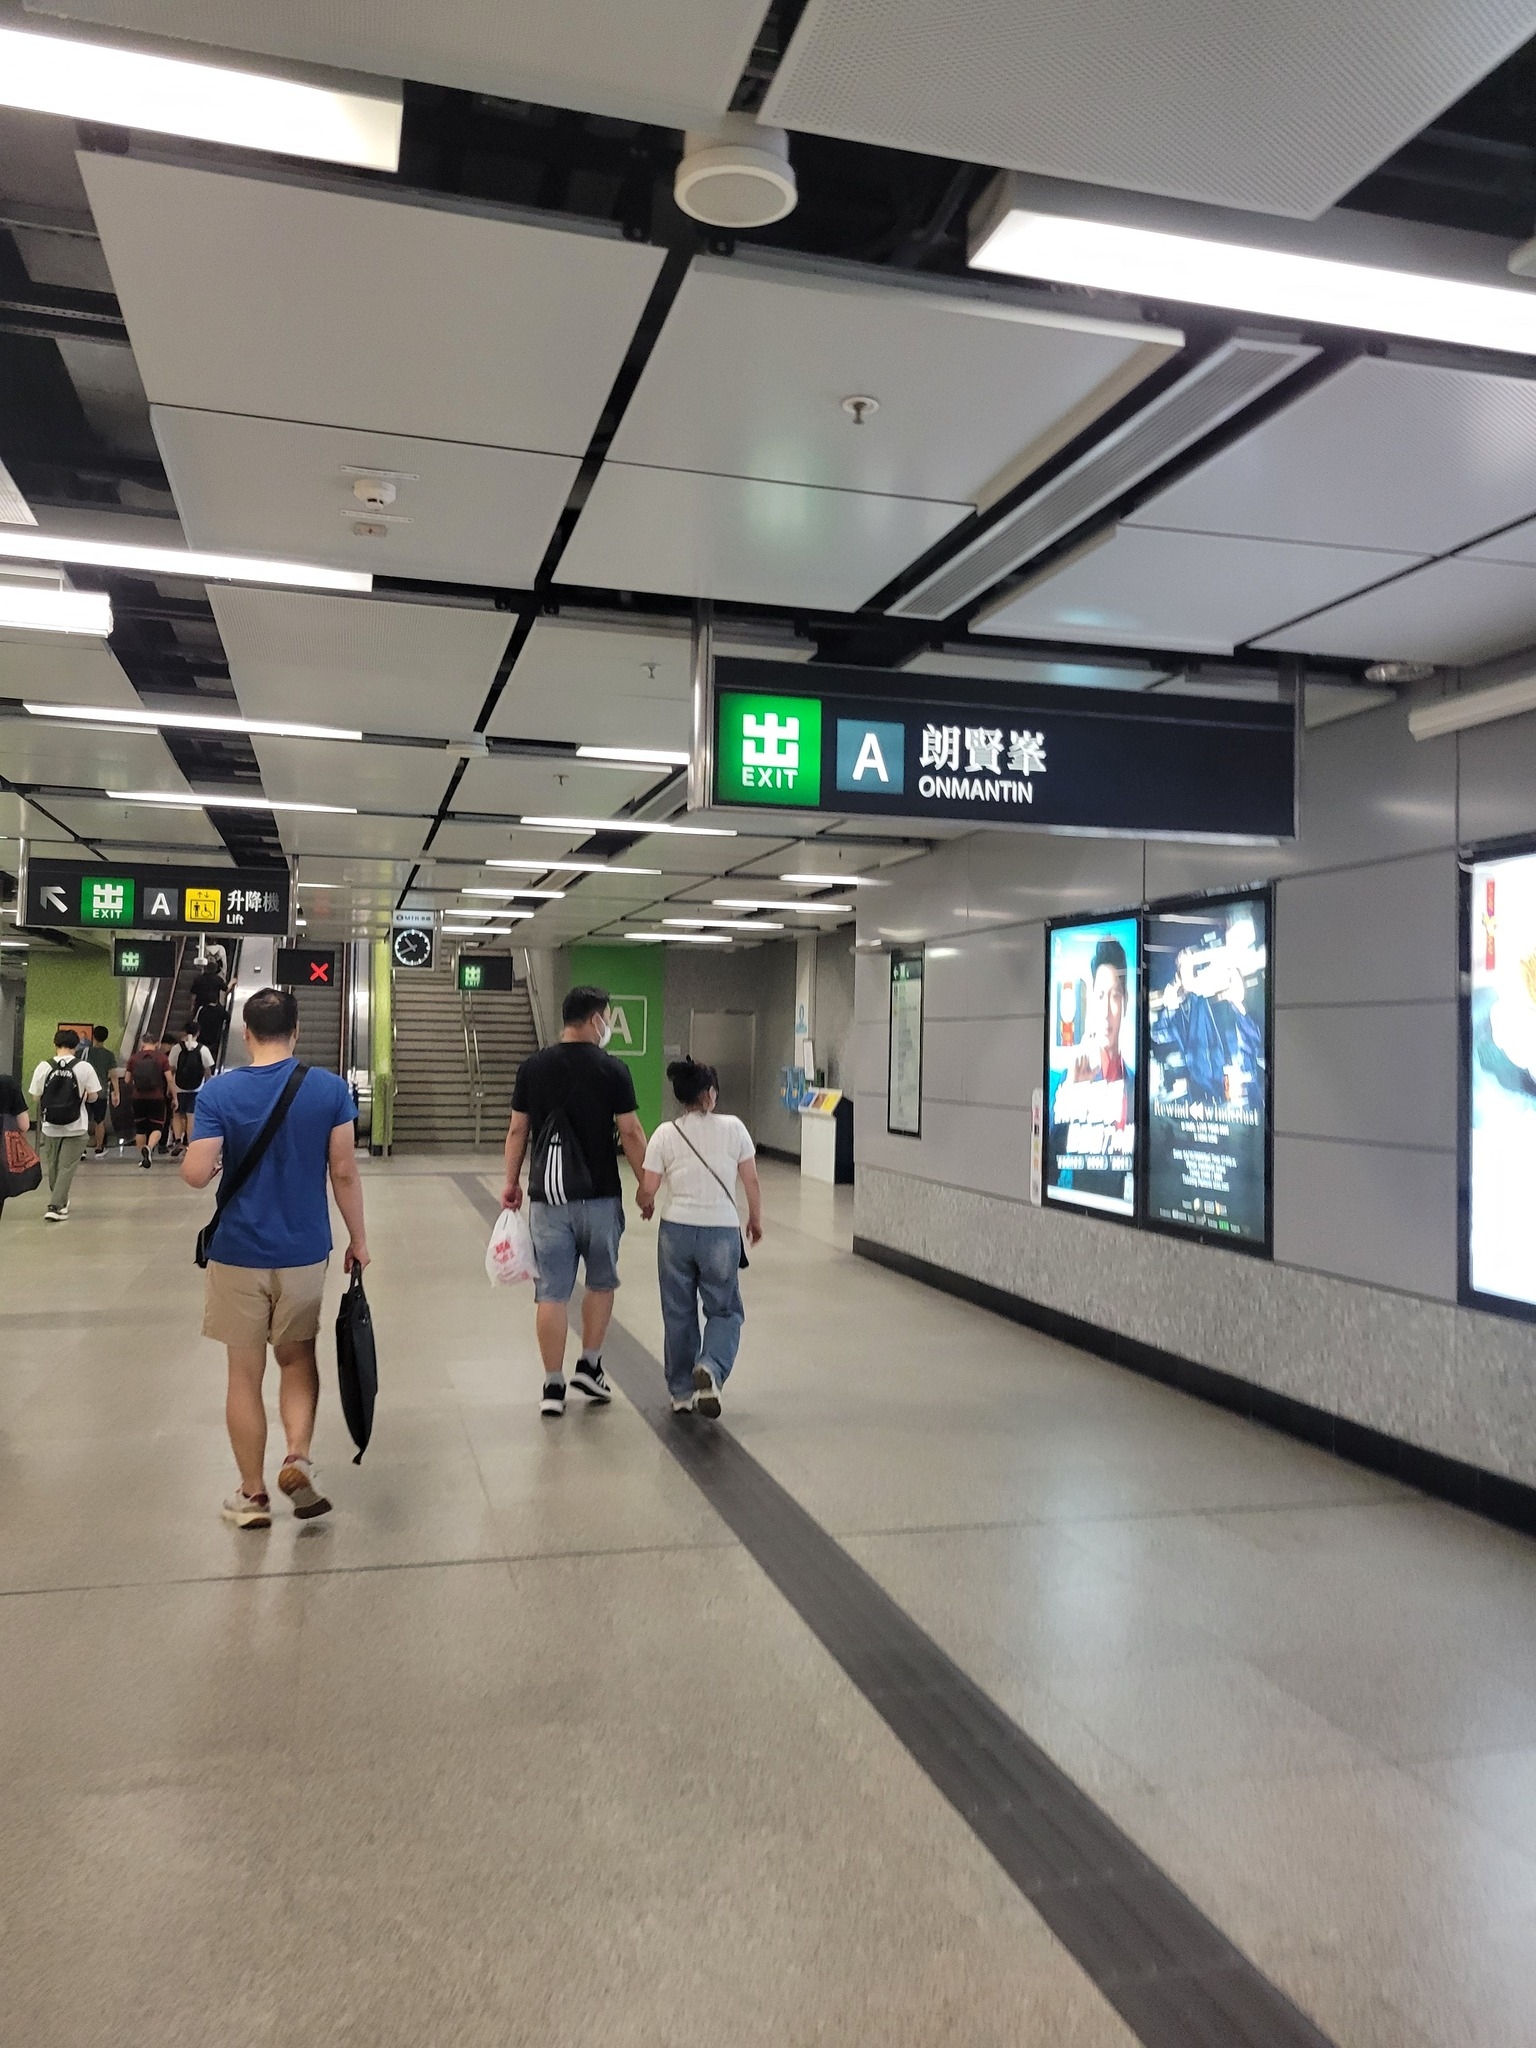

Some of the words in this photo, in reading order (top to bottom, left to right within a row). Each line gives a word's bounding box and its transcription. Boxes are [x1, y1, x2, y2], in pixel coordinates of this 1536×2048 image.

[851, 732, 890, 783] A
[741, 766, 799, 789] EXIT
[918, 775, 1034, 804] ONMANTIN
[151, 892, 171, 916] A
[226, 889, 280, 913] 升降機
[92, 908, 123, 920] EXIT
[226, 913, 244, 926] Lift
[609, 1006, 633, 1044] A
